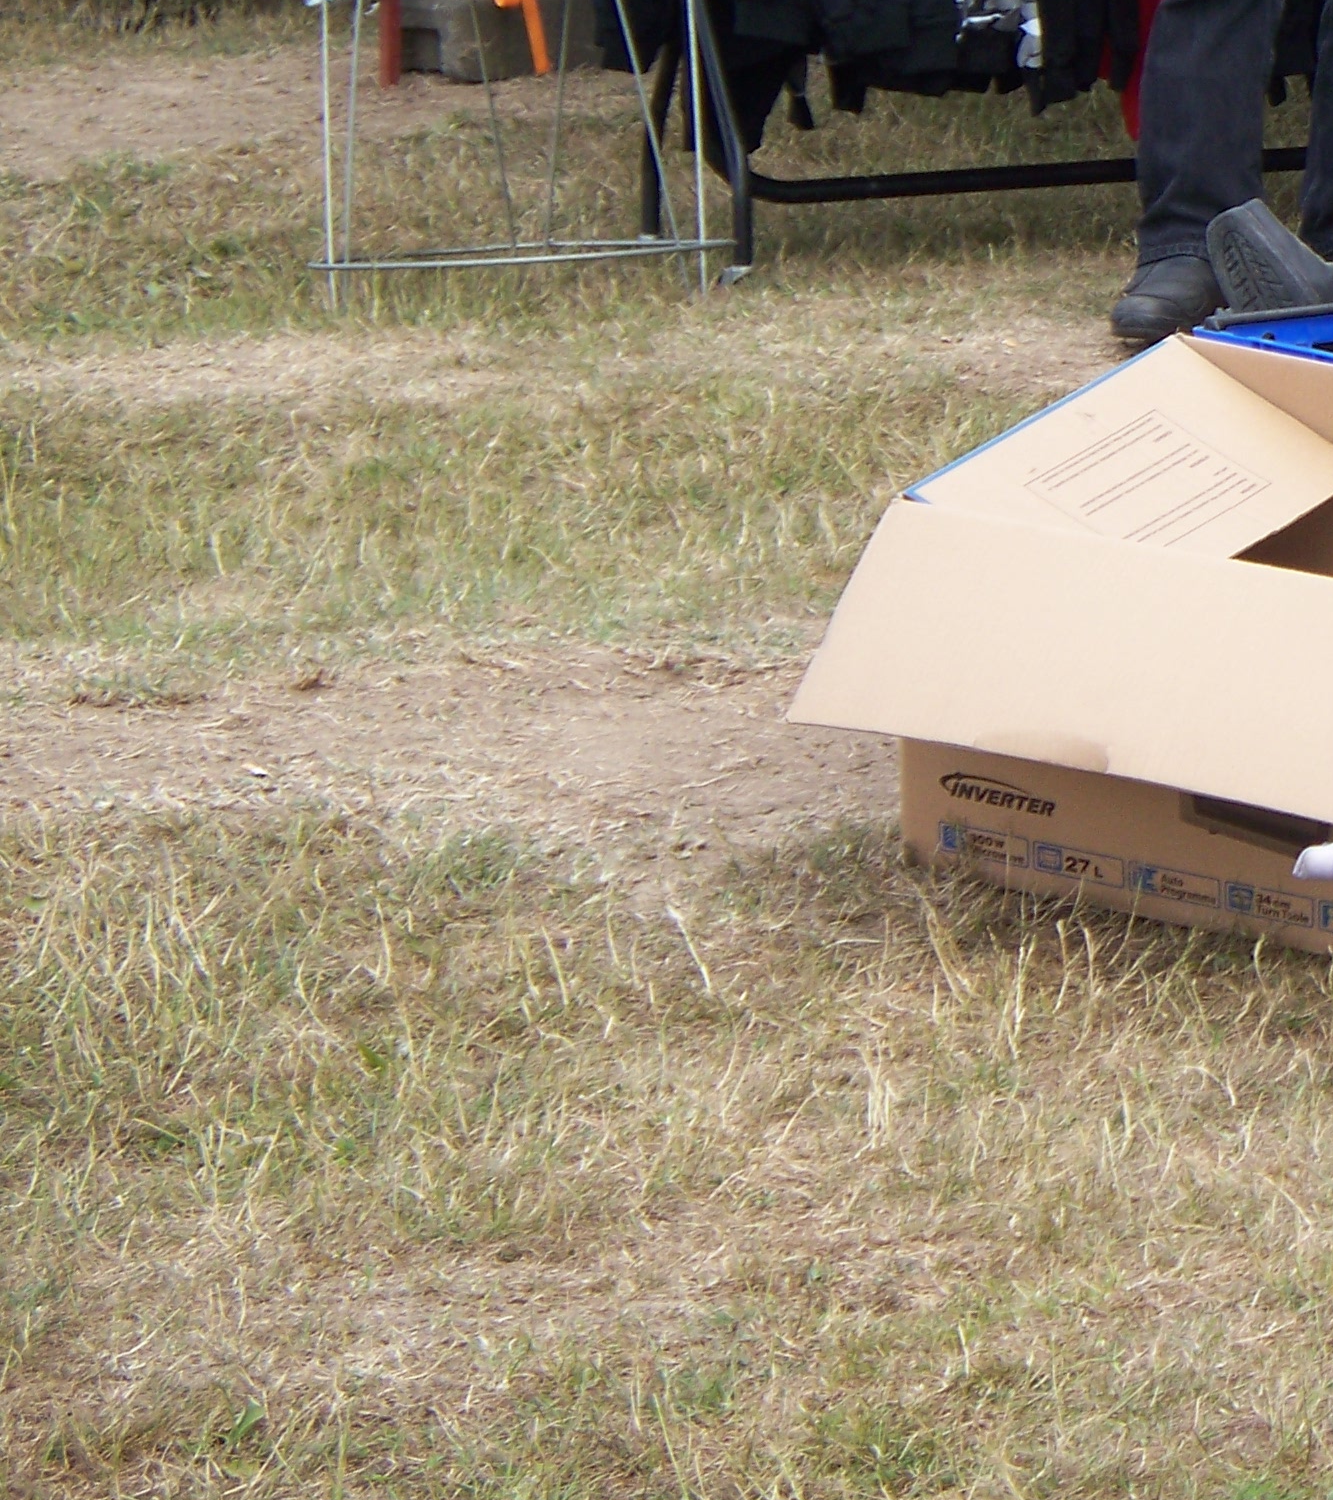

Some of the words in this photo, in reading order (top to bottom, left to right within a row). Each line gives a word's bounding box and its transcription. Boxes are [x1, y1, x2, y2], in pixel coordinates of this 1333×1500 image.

[950, 781, 1056, 817] INVERTER
[1065, 856, 1090, 874] 27
[1094, 866, 1104, 878] L
[1160, 874, 1184, 888] Auto
[1257, 905, 1280, 919] Turn
